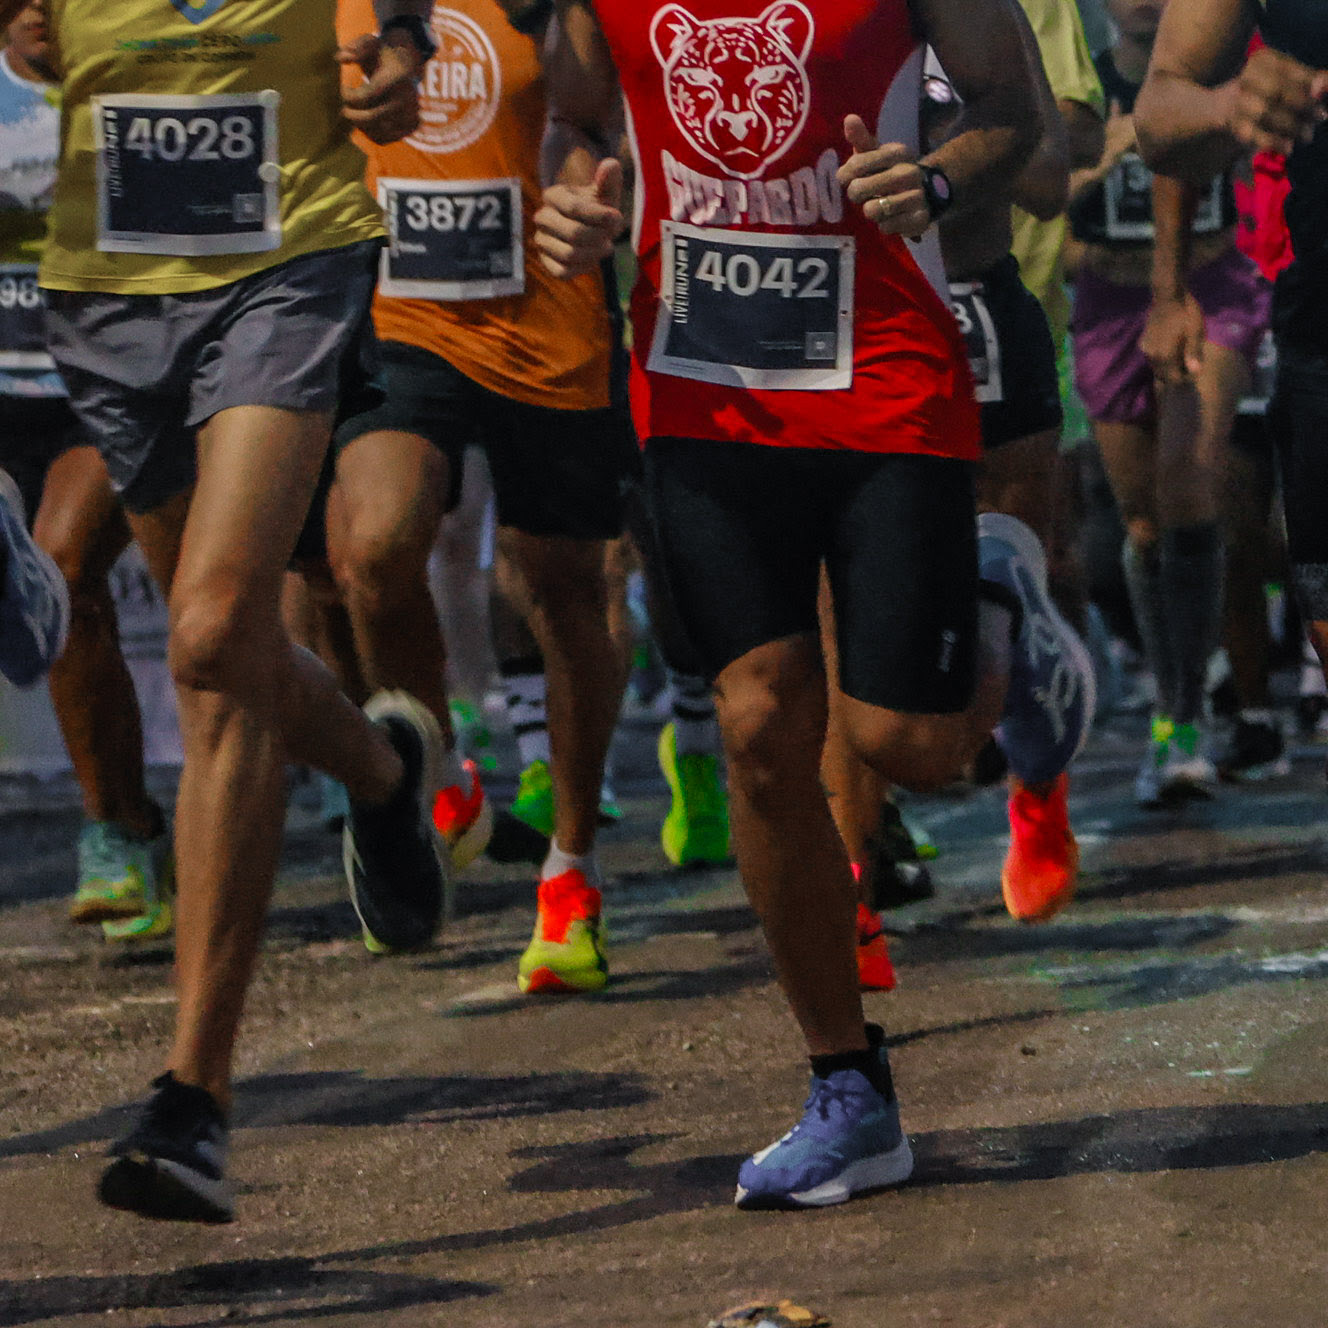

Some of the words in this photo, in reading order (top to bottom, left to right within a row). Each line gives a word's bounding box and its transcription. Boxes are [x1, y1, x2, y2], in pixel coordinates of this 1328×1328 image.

[416, 60, 489, 100] EIRA
[125, 115, 256, 163] 4028
[405, 195, 503, 232] 3872
[694, 250, 831, 299] 4042
